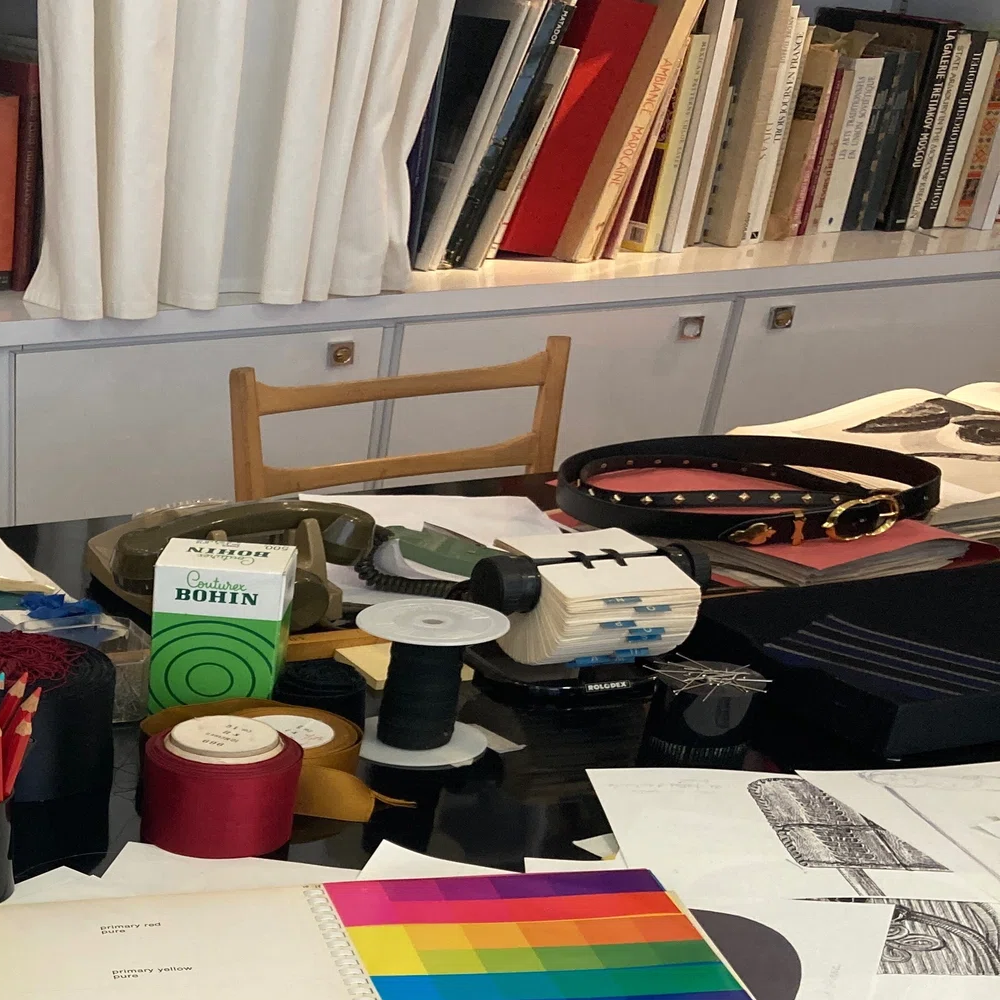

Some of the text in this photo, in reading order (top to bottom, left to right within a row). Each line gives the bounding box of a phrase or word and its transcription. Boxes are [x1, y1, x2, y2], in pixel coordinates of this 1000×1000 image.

[550, 11, 568, 45] MATADOR
[946, 29, 957, 41] LA
[789, 32, 804, 70] FRANCE
[936, 43, 954, 79] GALERIE
[609, 58, 674, 186] AMBIANCE MAROCAINE
[187, 546, 271, 558] BOHIN
[187, 570, 247, 591] Couturex
[175, 588, 259, 606] BOHIN
[587, 681, 629, 692] ROLODEX
[100, 923, 140, 931] primary
